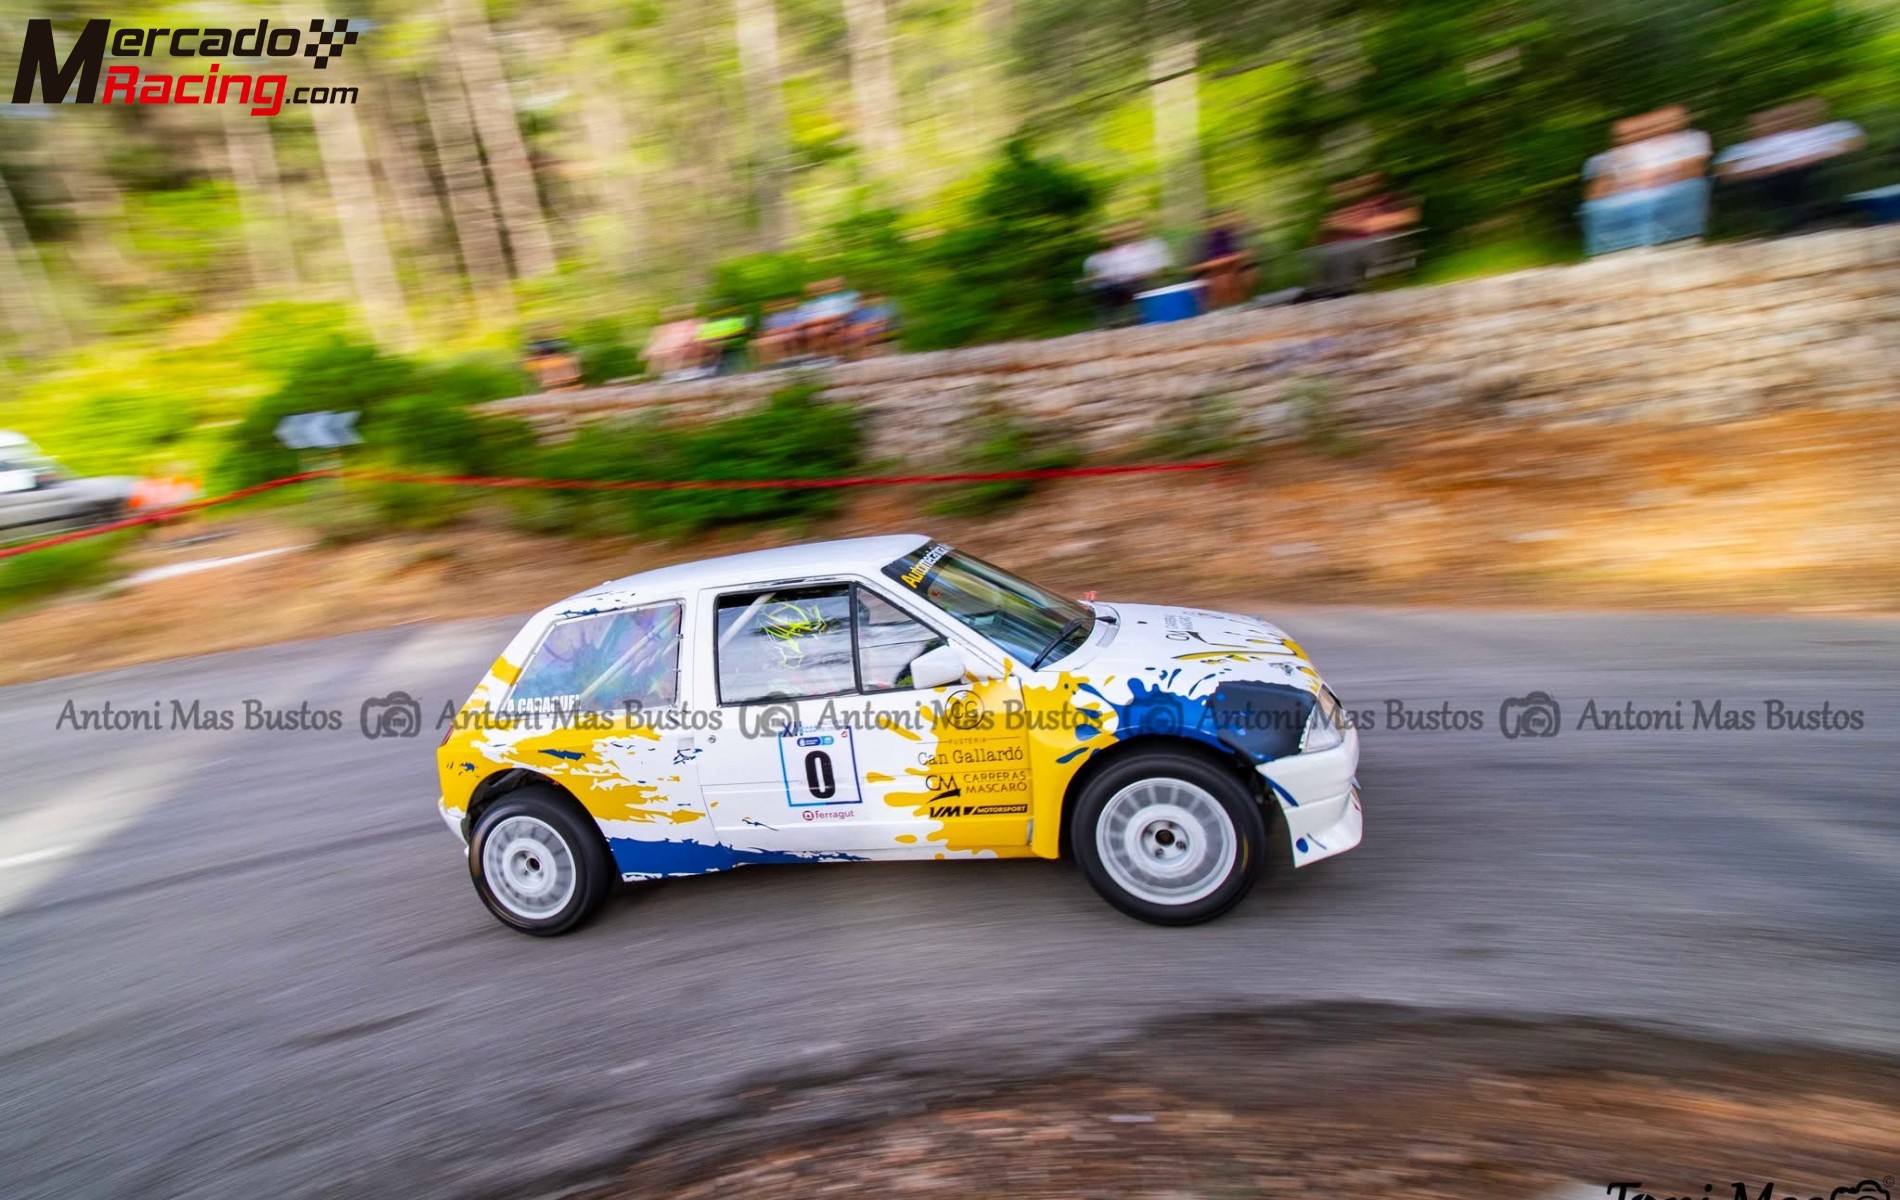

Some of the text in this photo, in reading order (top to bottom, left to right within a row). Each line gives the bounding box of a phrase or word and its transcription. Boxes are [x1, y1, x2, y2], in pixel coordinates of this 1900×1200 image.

[918, 746, 1024, 765] Can Gallardó
[804, 750, 836, 799] 0
[963, 771, 1026, 783] CARRERAS
[815, 810, 855, 819] ferragut
[976, 805, 1026, 814] MOTORSPORT
